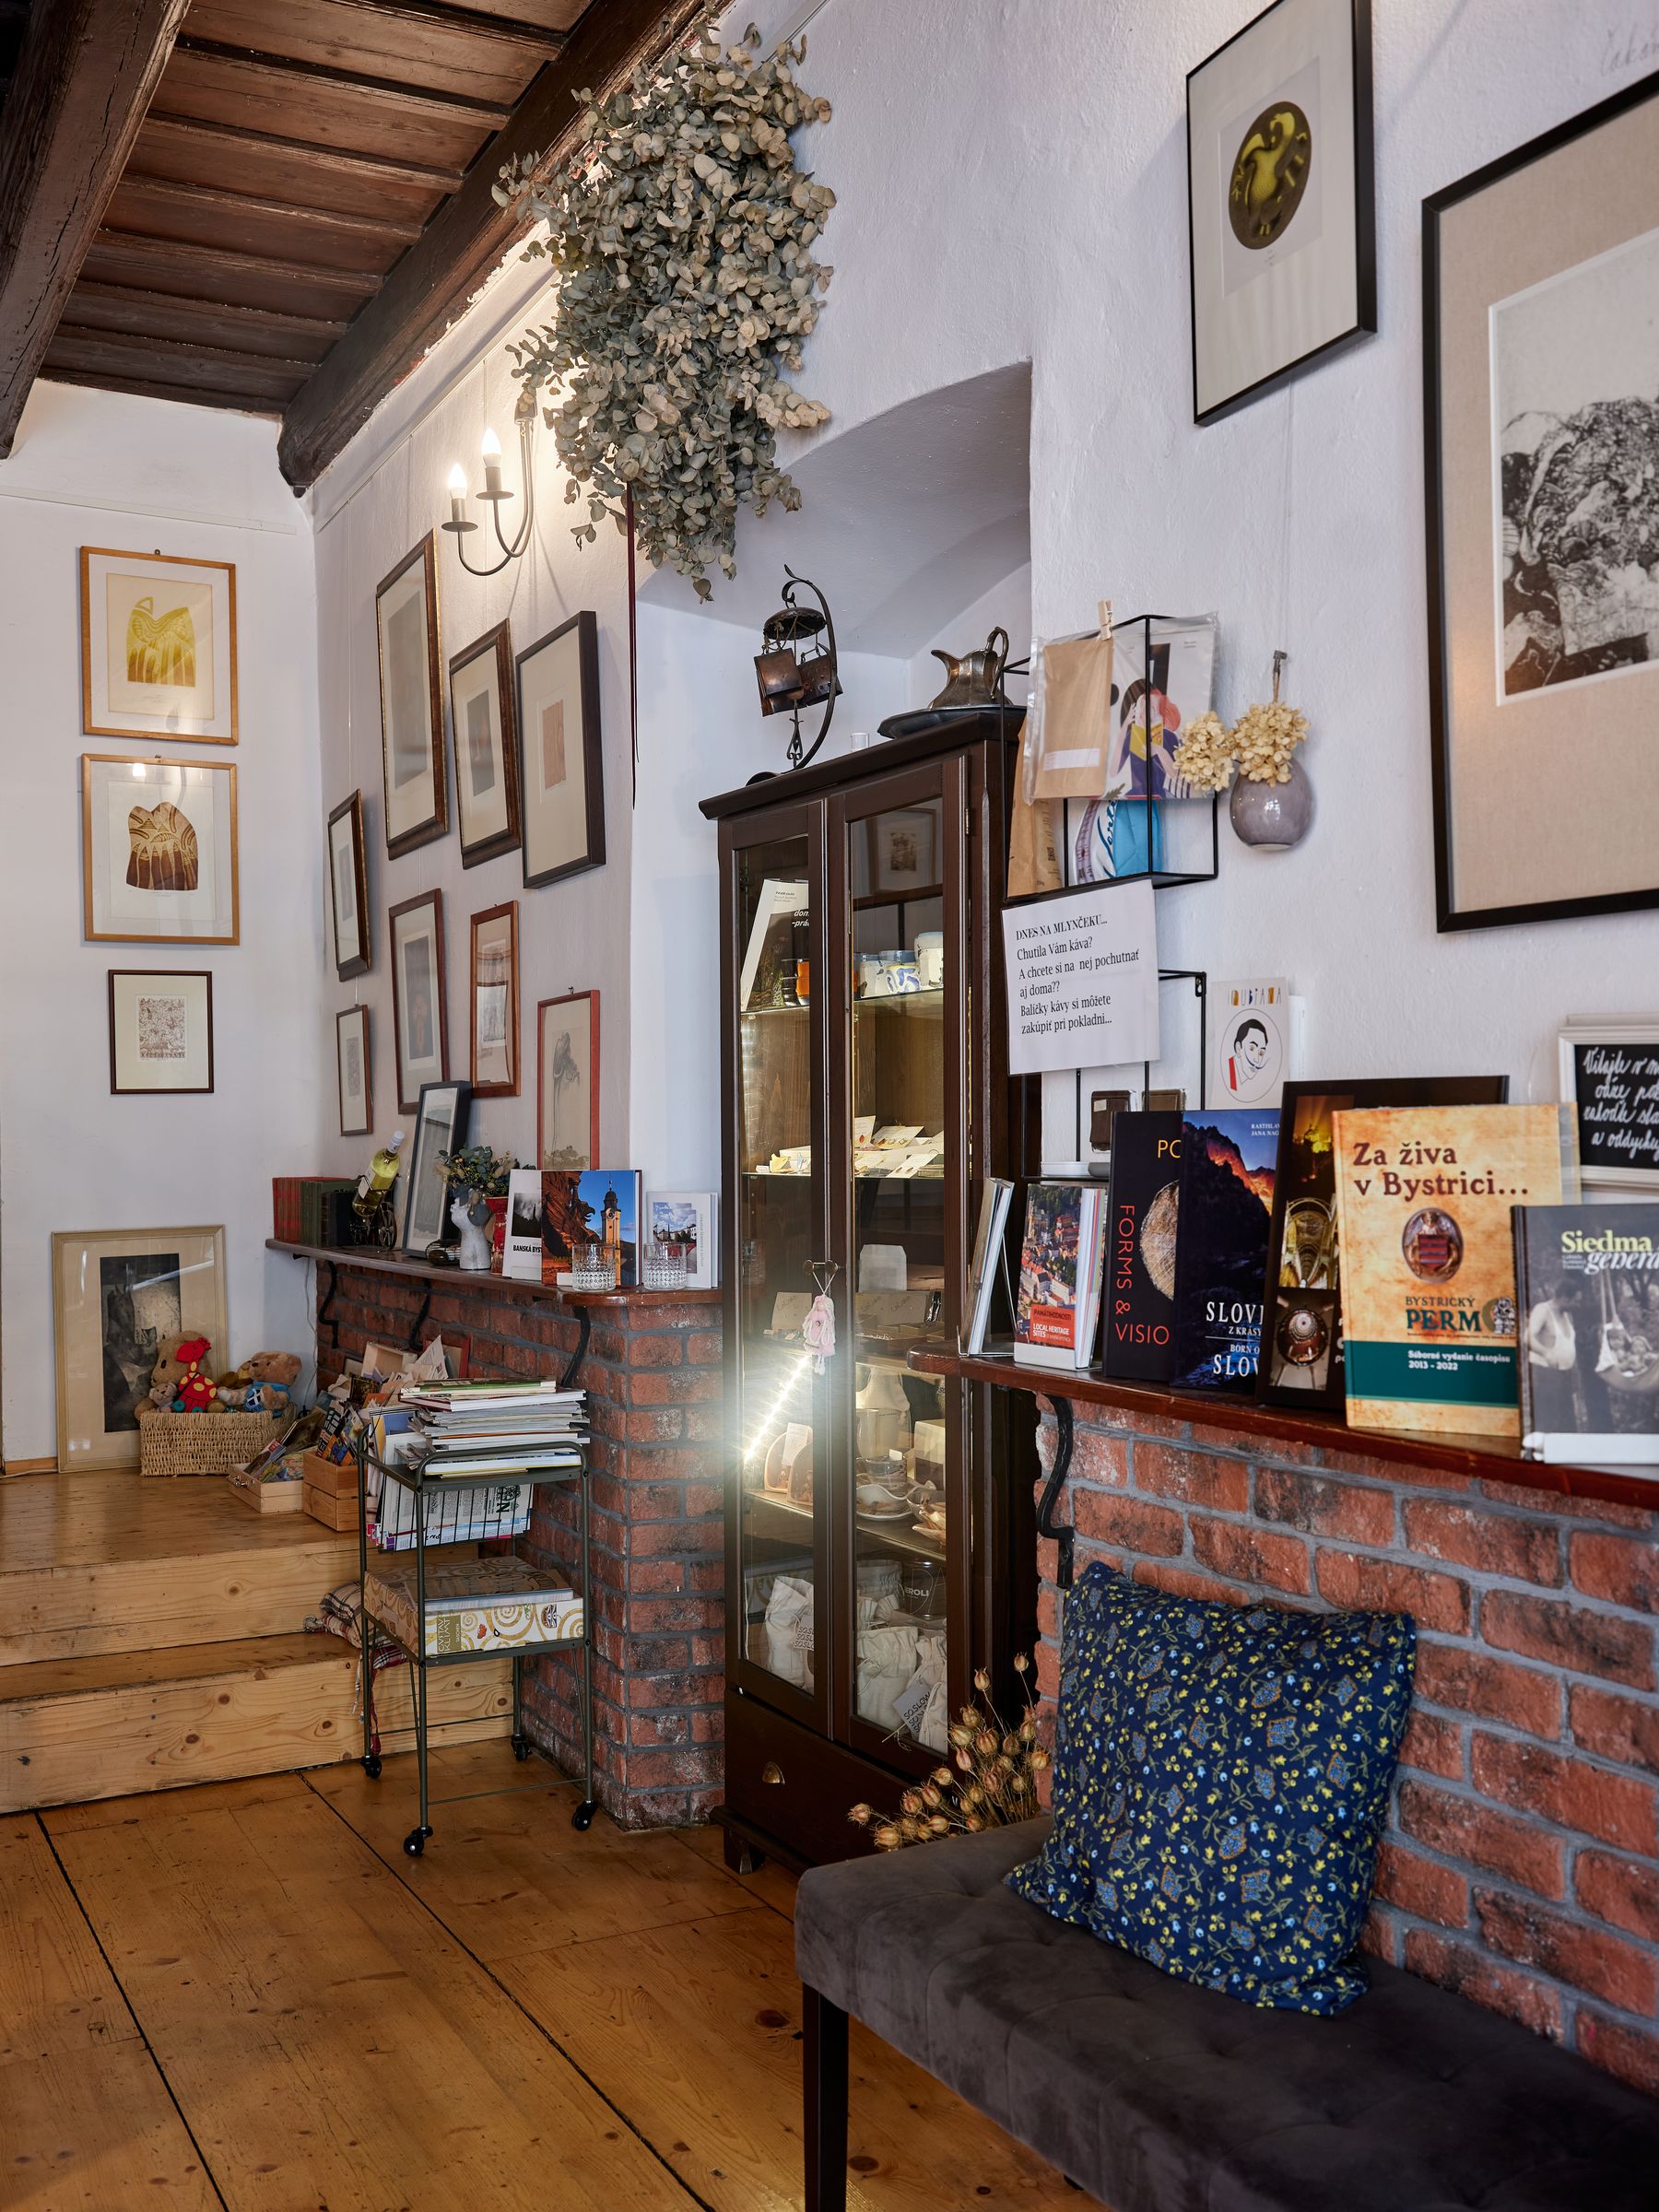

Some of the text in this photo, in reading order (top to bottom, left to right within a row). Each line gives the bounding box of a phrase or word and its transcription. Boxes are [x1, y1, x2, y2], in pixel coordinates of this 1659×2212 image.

[1016, 914, 1107, 941] DNES NA MLYNČEKU...
[1017, 936, 1093, 960] Chutila Vám káva?
[1018, 948, 1140, 980] A chcete si na nej pochutnať
[1019, 981, 1061, 1000] aj doma??
[1051, 999, 1070, 1014] kávy
[1072, 998, 1079, 1010] si
[1081, 994, 1112, 1008] môžete
[1021, 1013, 1112, 1035] zakúpiť pri pokladni...
[1353, 1140, 1458, 1166] Za živa
[1353, 1170, 1528, 1203] v Bystrici...
[512, 1244, 532, 1253] BANSKÁ
[1560, 1229, 1653, 1253] Siedma
[1115, 1205, 1135, 1315] FORMS &
[1406, 1295, 1476, 1308] BYSTRICKÝ
[1033, 1323, 1070, 1335] LOCAL HERITAGE
[1033, 1329, 1046, 1338] SITES
[1230, 1344, 1252, 1354] BORN
[1408, 1360, 1429, 1370] 2013
[1436, 1361, 1458, 1371] 2022
